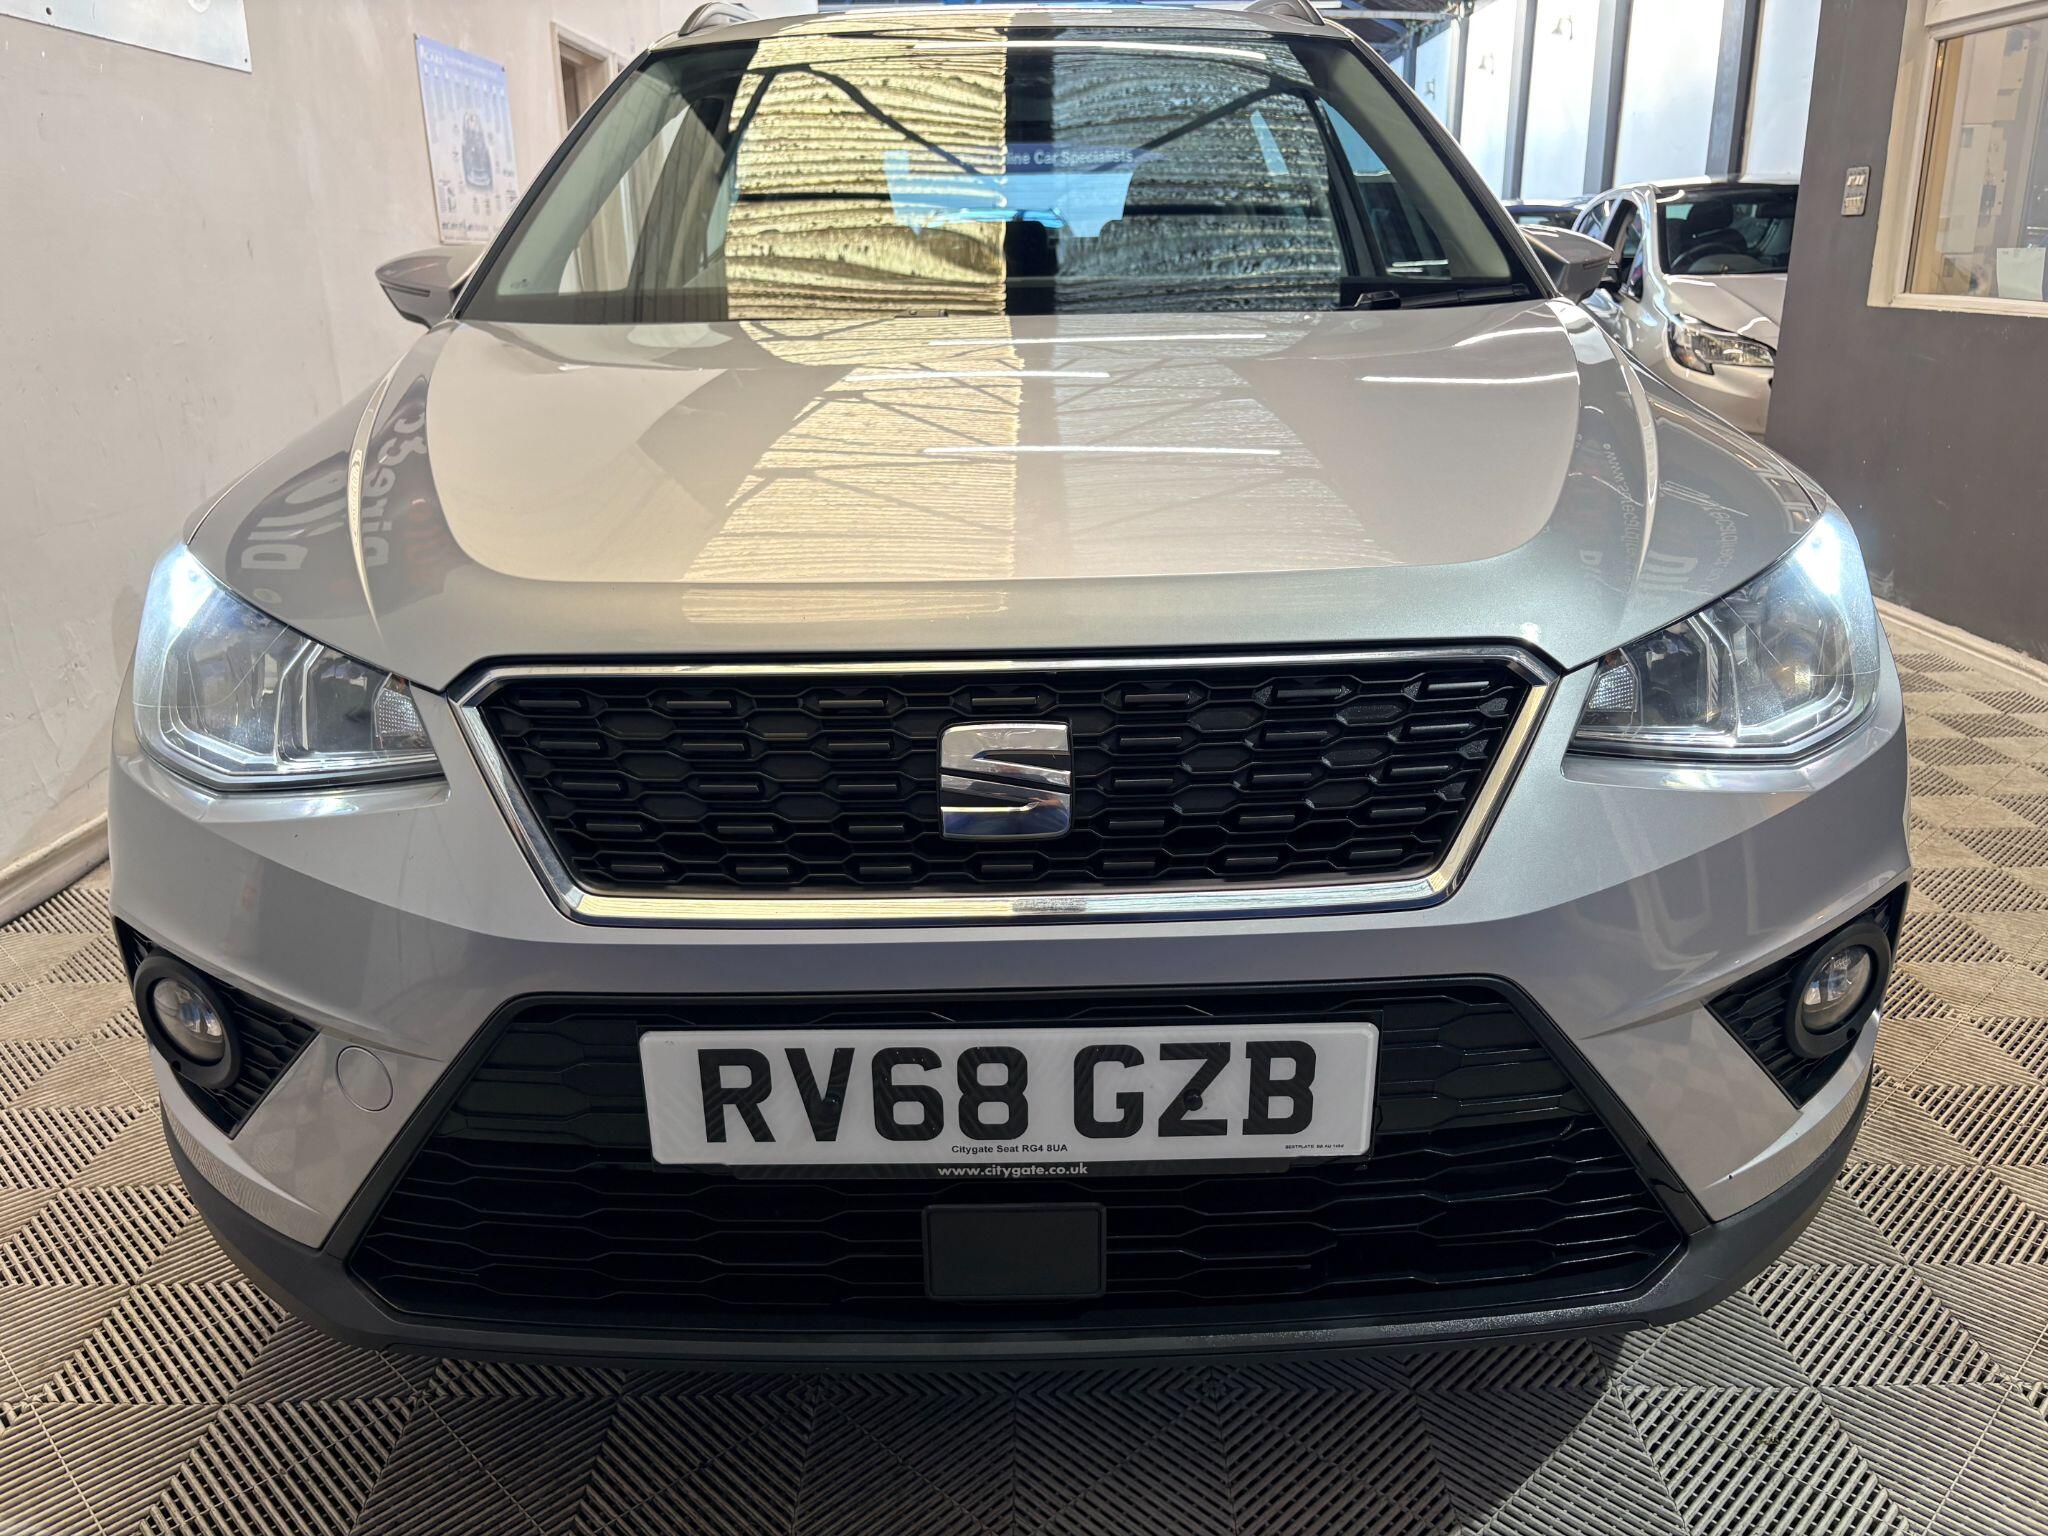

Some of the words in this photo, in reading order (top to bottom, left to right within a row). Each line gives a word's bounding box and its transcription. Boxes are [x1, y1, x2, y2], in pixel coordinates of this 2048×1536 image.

[1034, 150, 1058, 165] Car
[1061, 150, 1133, 166] Specialists
[697, 1046, 1029, 1143] RV68
[1073, 1040, 1317, 1139] GZB
[951, 1144, 993, 1155] Citygate
[996, 1144, 1019, 1153] Seat
[1022, 1144, 1043, 1152] RG4
[1046, 1144, 1068, 1152] 8UA
[937, 1162, 1088, 1178] www.citygate.co.uk
